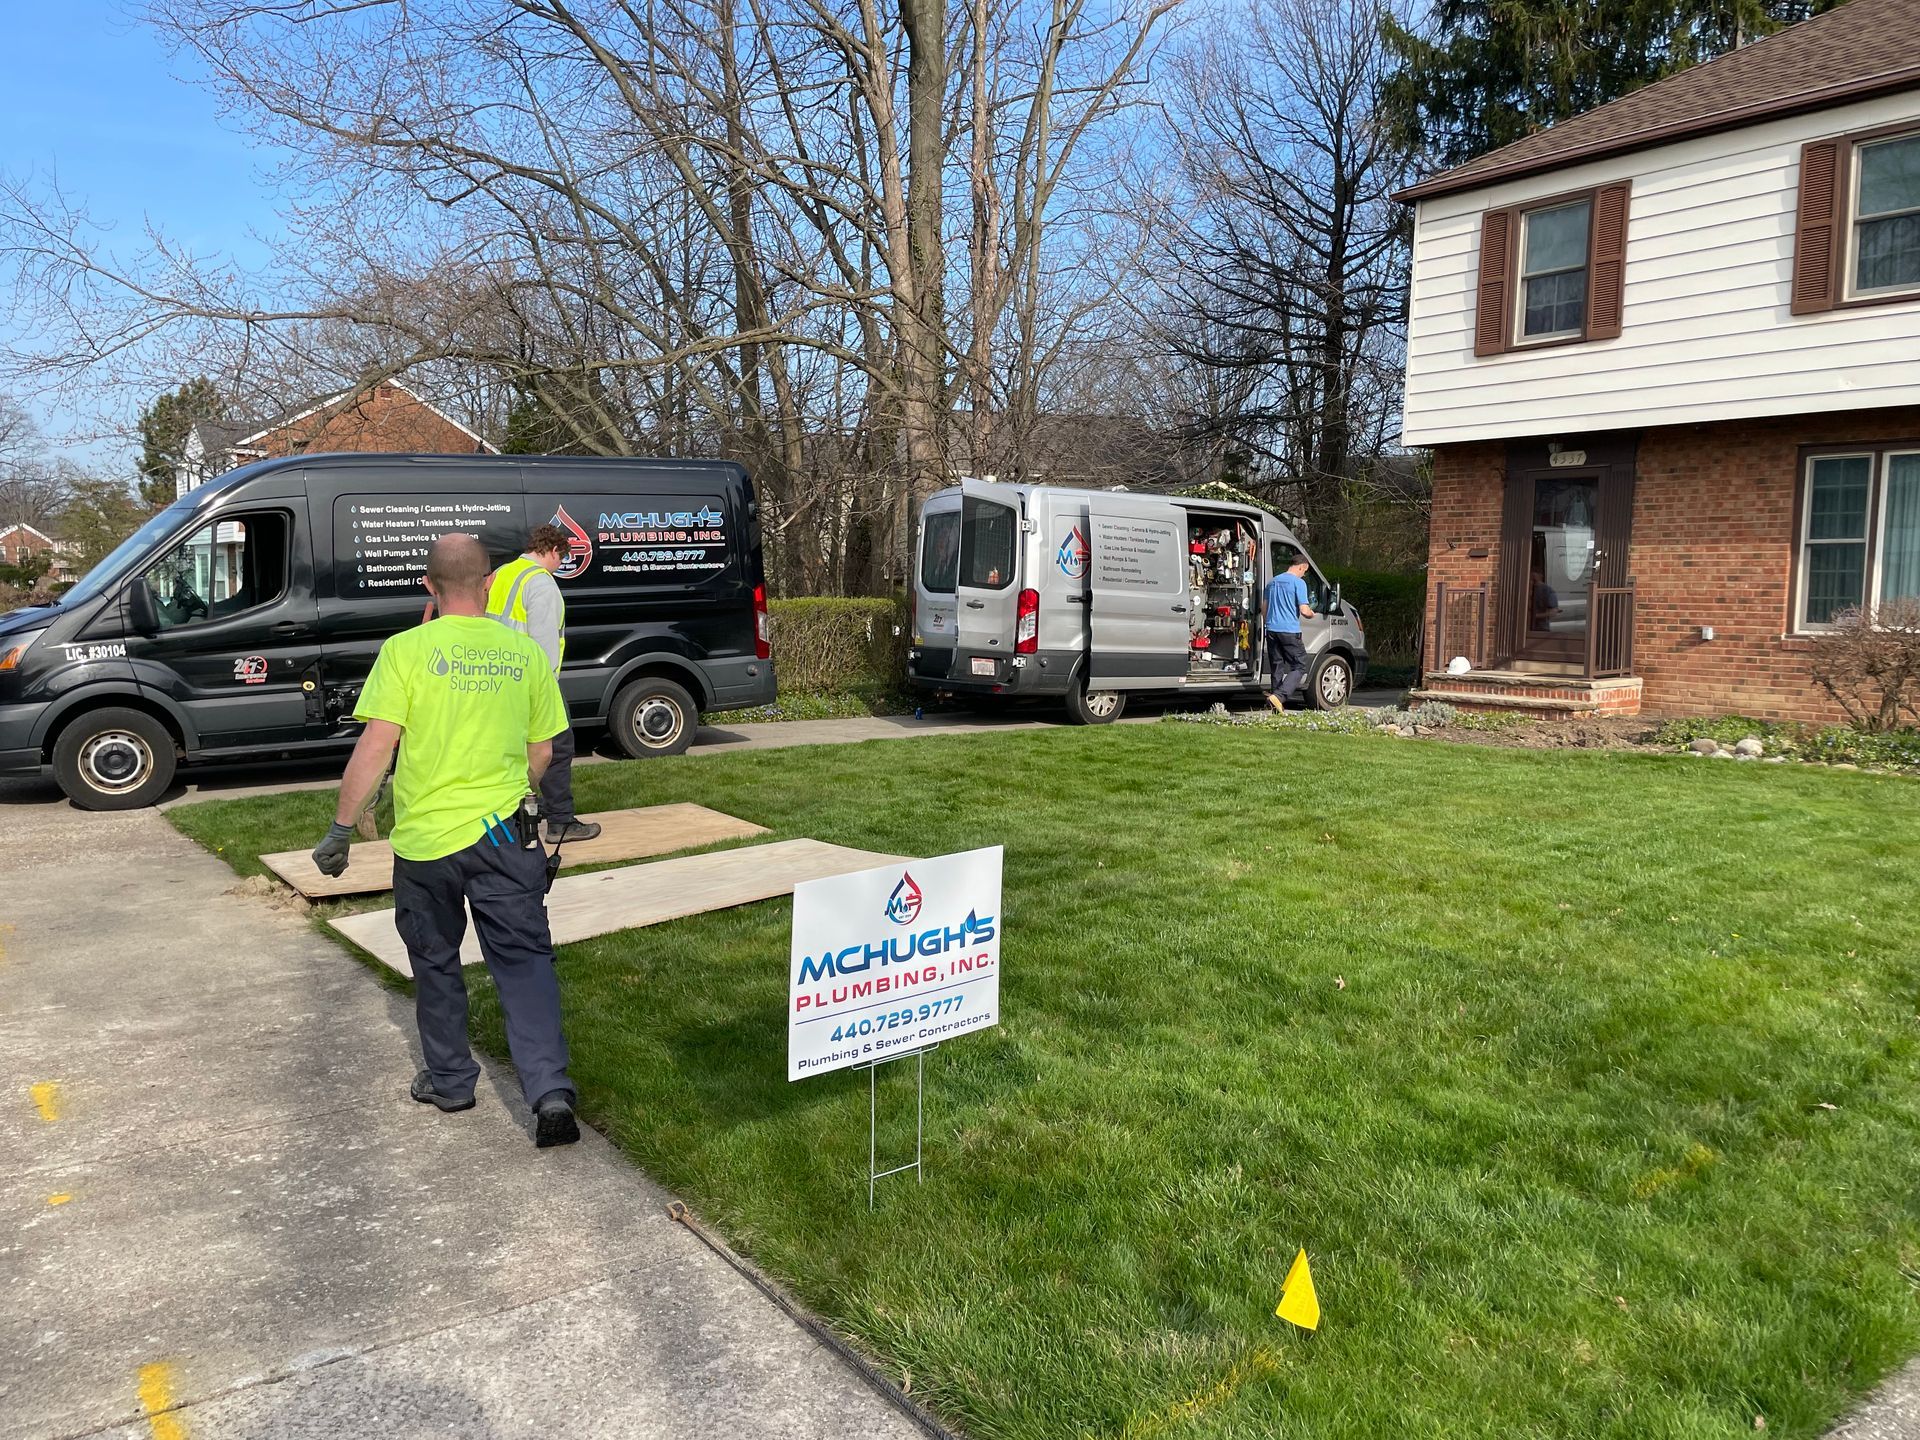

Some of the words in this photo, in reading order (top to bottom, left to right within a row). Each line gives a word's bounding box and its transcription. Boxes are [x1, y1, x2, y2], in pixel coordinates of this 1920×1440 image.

[360, 505, 384, 514] Sewer
[385, 505, 419, 514] Cleaning
[425, 504, 453, 512] Camera
[455, 504, 461, 512] &
[462, 504, 511, 513] Hydro-Jetting
[361, 520, 384, 528] Water
[385, 520, 415, 528] Heaters
[420, 519, 453, 527] Tankless
[455, 518, 486, 527] Systems
[365, 535, 381, 543] Gas
[383, 534, 400, 542] Line
[401, 533, 430, 542] Service
[431, 533, 437, 541] &
[598, 531, 692, 543] PLUMBING,
[693, 530, 726, 541] INC.
[365, 550, 382, 558] Well
[383, 549, 410, 558] Pumps
[412, 548, 418, 556] &
[621, 549, 706, 562] 440.729.9777
[366, 564, 404, 573] Bathroom
[602, 564, 641, 572] Plumbing
[650, 563, 676, 571] Sewer
[676, 562, 725, 570] Contractors
[368, 578, 411, 587] Residential
[65, 648, 87, 660] LIC.
[88, 644, 127, 659] #30104
[451, 661, 523, 681] Plumbing
[450, 675, 503, 694] Supply
[797, 907, 995, 986] MCHUGH'S
[796, 966, 944, 1012] PLUMBING,
[950, 953, 994, 976] INC.
[830, 995, 964, 1042] 440.729.9777
[798, 1048, 859, 1070] Plumbing
[862, 1043, 872, 1053] &
[875, 1033, 915, 1050] Sewer
[919, 1012, 991, 1038] Contractors
